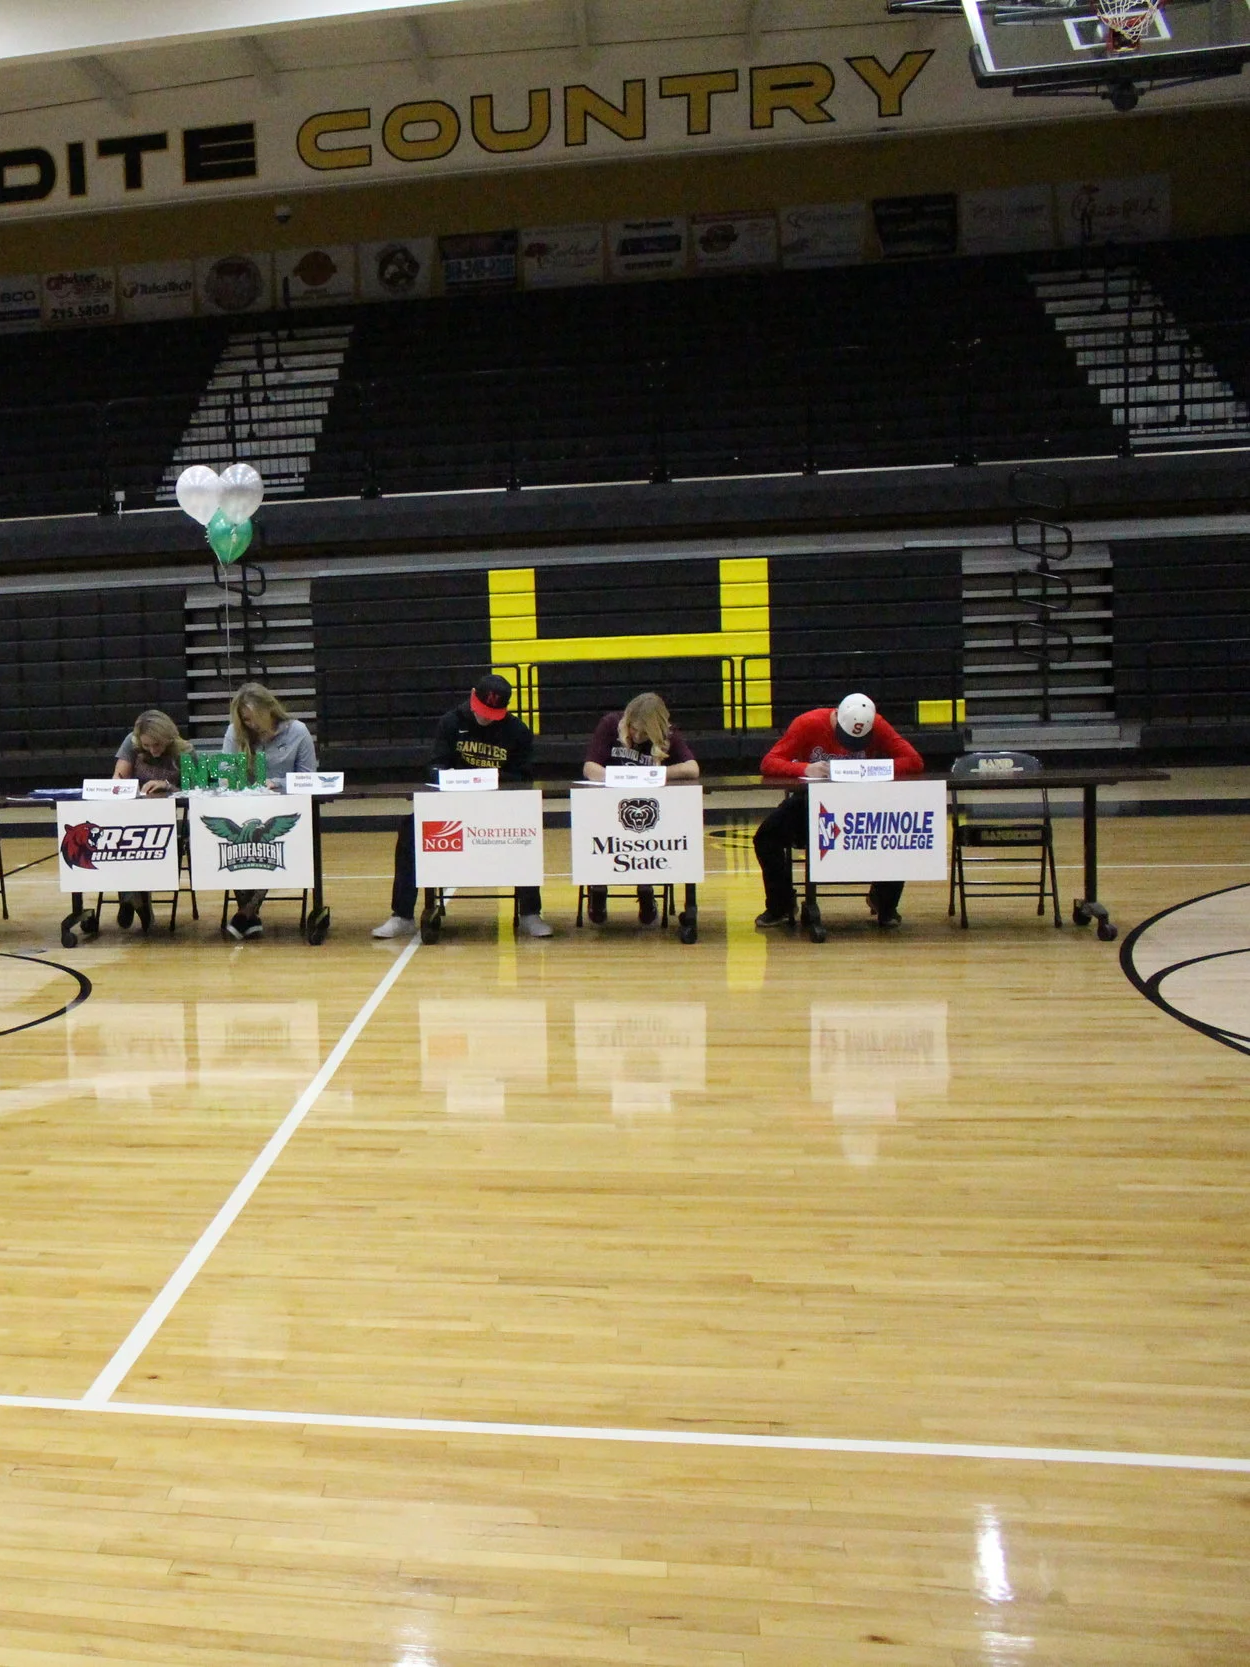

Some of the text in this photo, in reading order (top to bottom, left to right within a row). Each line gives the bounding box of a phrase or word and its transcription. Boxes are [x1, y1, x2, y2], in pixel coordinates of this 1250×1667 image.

[295, 48, 936, 171] COUNTRY
[852, 722, 865, 735] S
[455, 740, 508, 761] SANDITES
[463, 755, 502, 769] ASEBALL
[843, 811, 934, 834] SEMINOLE
[96, 825, 173, 849] RSU
[466, 826, 537, 838] NORTHERN
[424, 838, 462, 850] NOC
[471, 838, 532, 848] Oklahoma College
[592, 835, 688, 855] Missouri
[842, 834, 934, 850] STATE COLLEGE
[91, 849, 165, 861] HILLCATS
[220, 842, 284, 868] NORTHEASTERN
[613, 853, 668, 873] State
